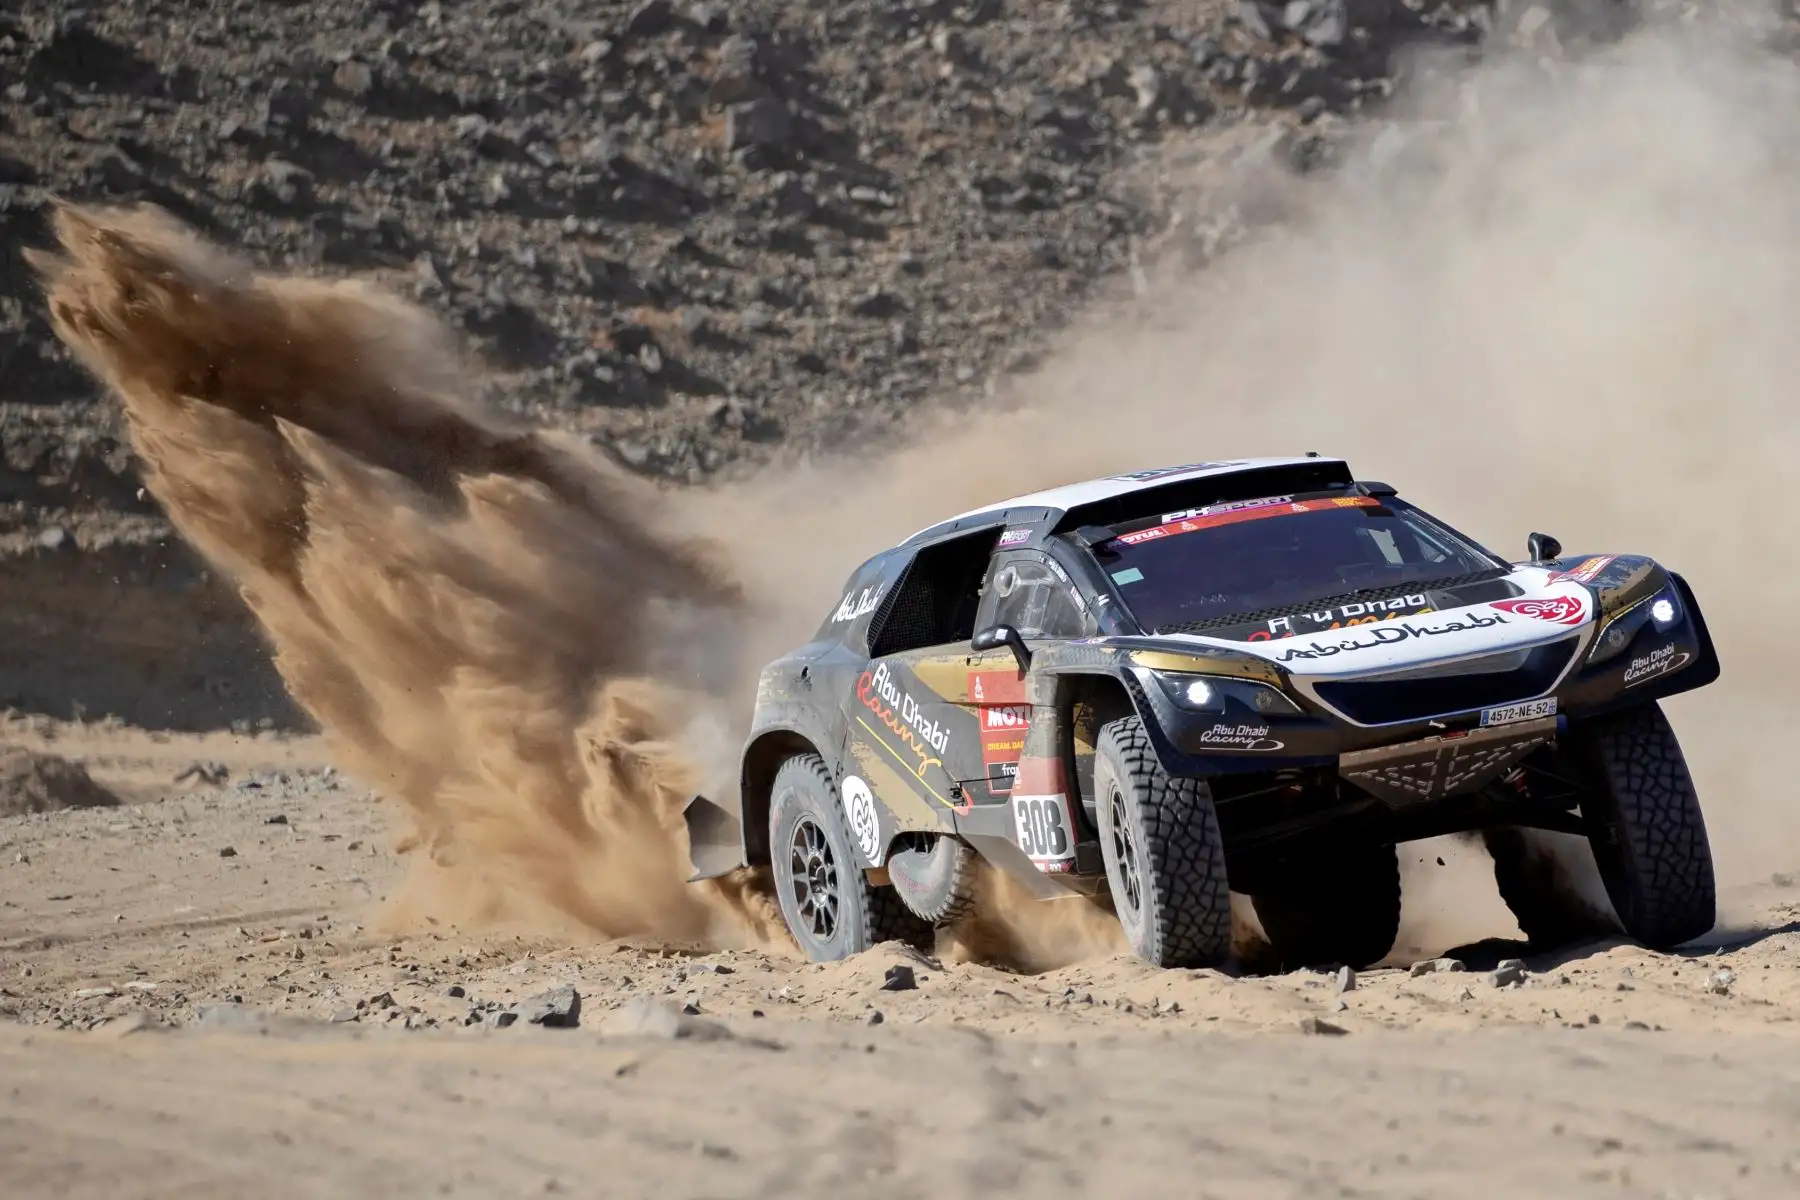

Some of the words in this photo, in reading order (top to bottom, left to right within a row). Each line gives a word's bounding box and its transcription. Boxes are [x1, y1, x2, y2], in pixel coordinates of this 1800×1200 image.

[1267, 610, 1334, 634] Au
[1624, 655, 1675, 682] Racing
[1632, 656, 1650, 670] Abu
[1650, 642, 1675, 662] Dhabi
[872, 662, 901, 711] Abu
[902, 692, 951, 755] Dhabi
[1490, 701, 1549, 722] 4572-NE-52
[857, 671, 942, 776] Racing
[1213, 724, 1235, 736] Abu
[1236, 725, 1270, 736] Dhabi
[1200, 731, 1265, 750] Racing
[1017, 800, 1067, 856] 308
